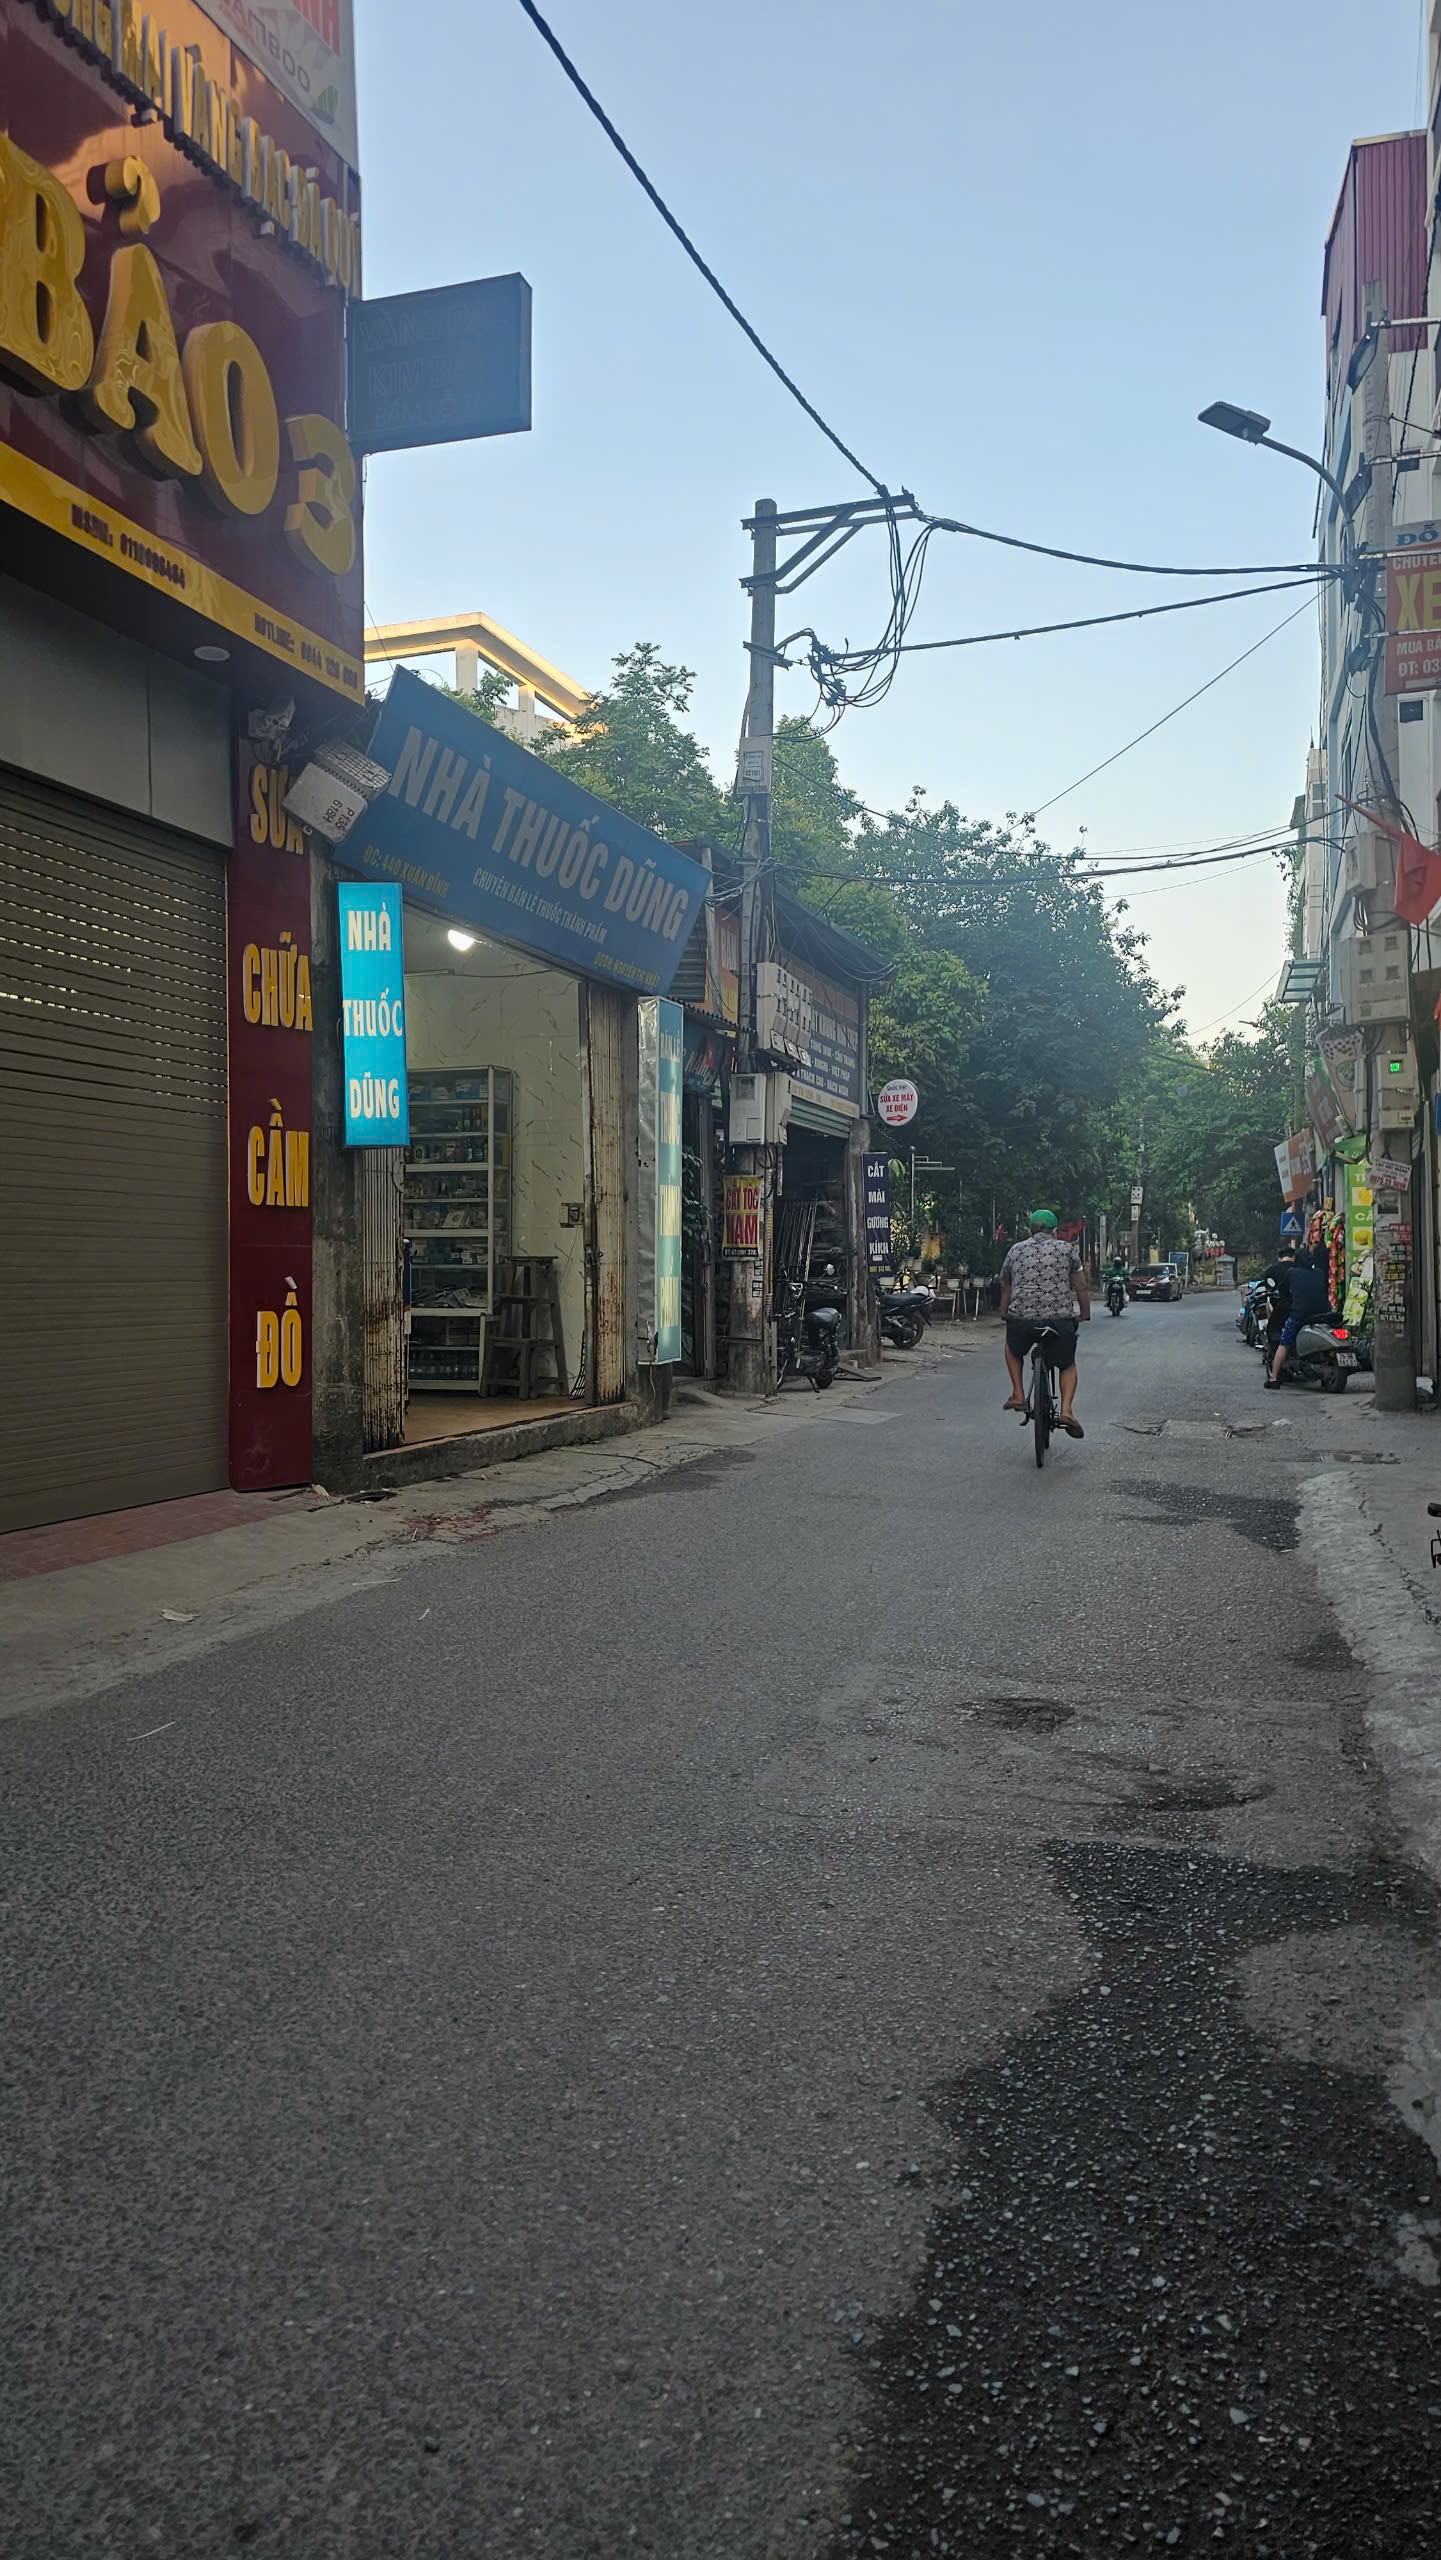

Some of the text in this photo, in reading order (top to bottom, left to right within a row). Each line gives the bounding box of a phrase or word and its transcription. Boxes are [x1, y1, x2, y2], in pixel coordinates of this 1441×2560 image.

[0, 130, 281, 516] BẢO
[1395, 570, 1441, 632] XE
[1396, 640, 1423, 656] MUA
[1423, 658, 1441, 674] 03
[387, 724, 690, 942] NHÀ THUỐC DŨNG
[473, 866, 509, 900] CHUYÊN
[535, 898, 564, 925] THUỐC
[348, 902, 391, 951] NHÀ
[242, 931, 313, 1031] CHỮA
[343, 987, 403, 1037] THUỐC
[349, 1071, 401, 1120] DŨNG
[886, 1104, 893, 1112] XE
[892, 1094, 900, 1102] XE
[901, 1092, 914, 1102] MÁY
[248, 1098, 310, 1207] CẦM
[867, 1161, 885, 1178] CẮT
[868, 1188, 886, 1203] MÀI
[726, 1214, 758, 1245] NAM
[867, 1216, 889, 1229] GƯƠNG
[256, 1276, 302, 1389] ĐỒ
